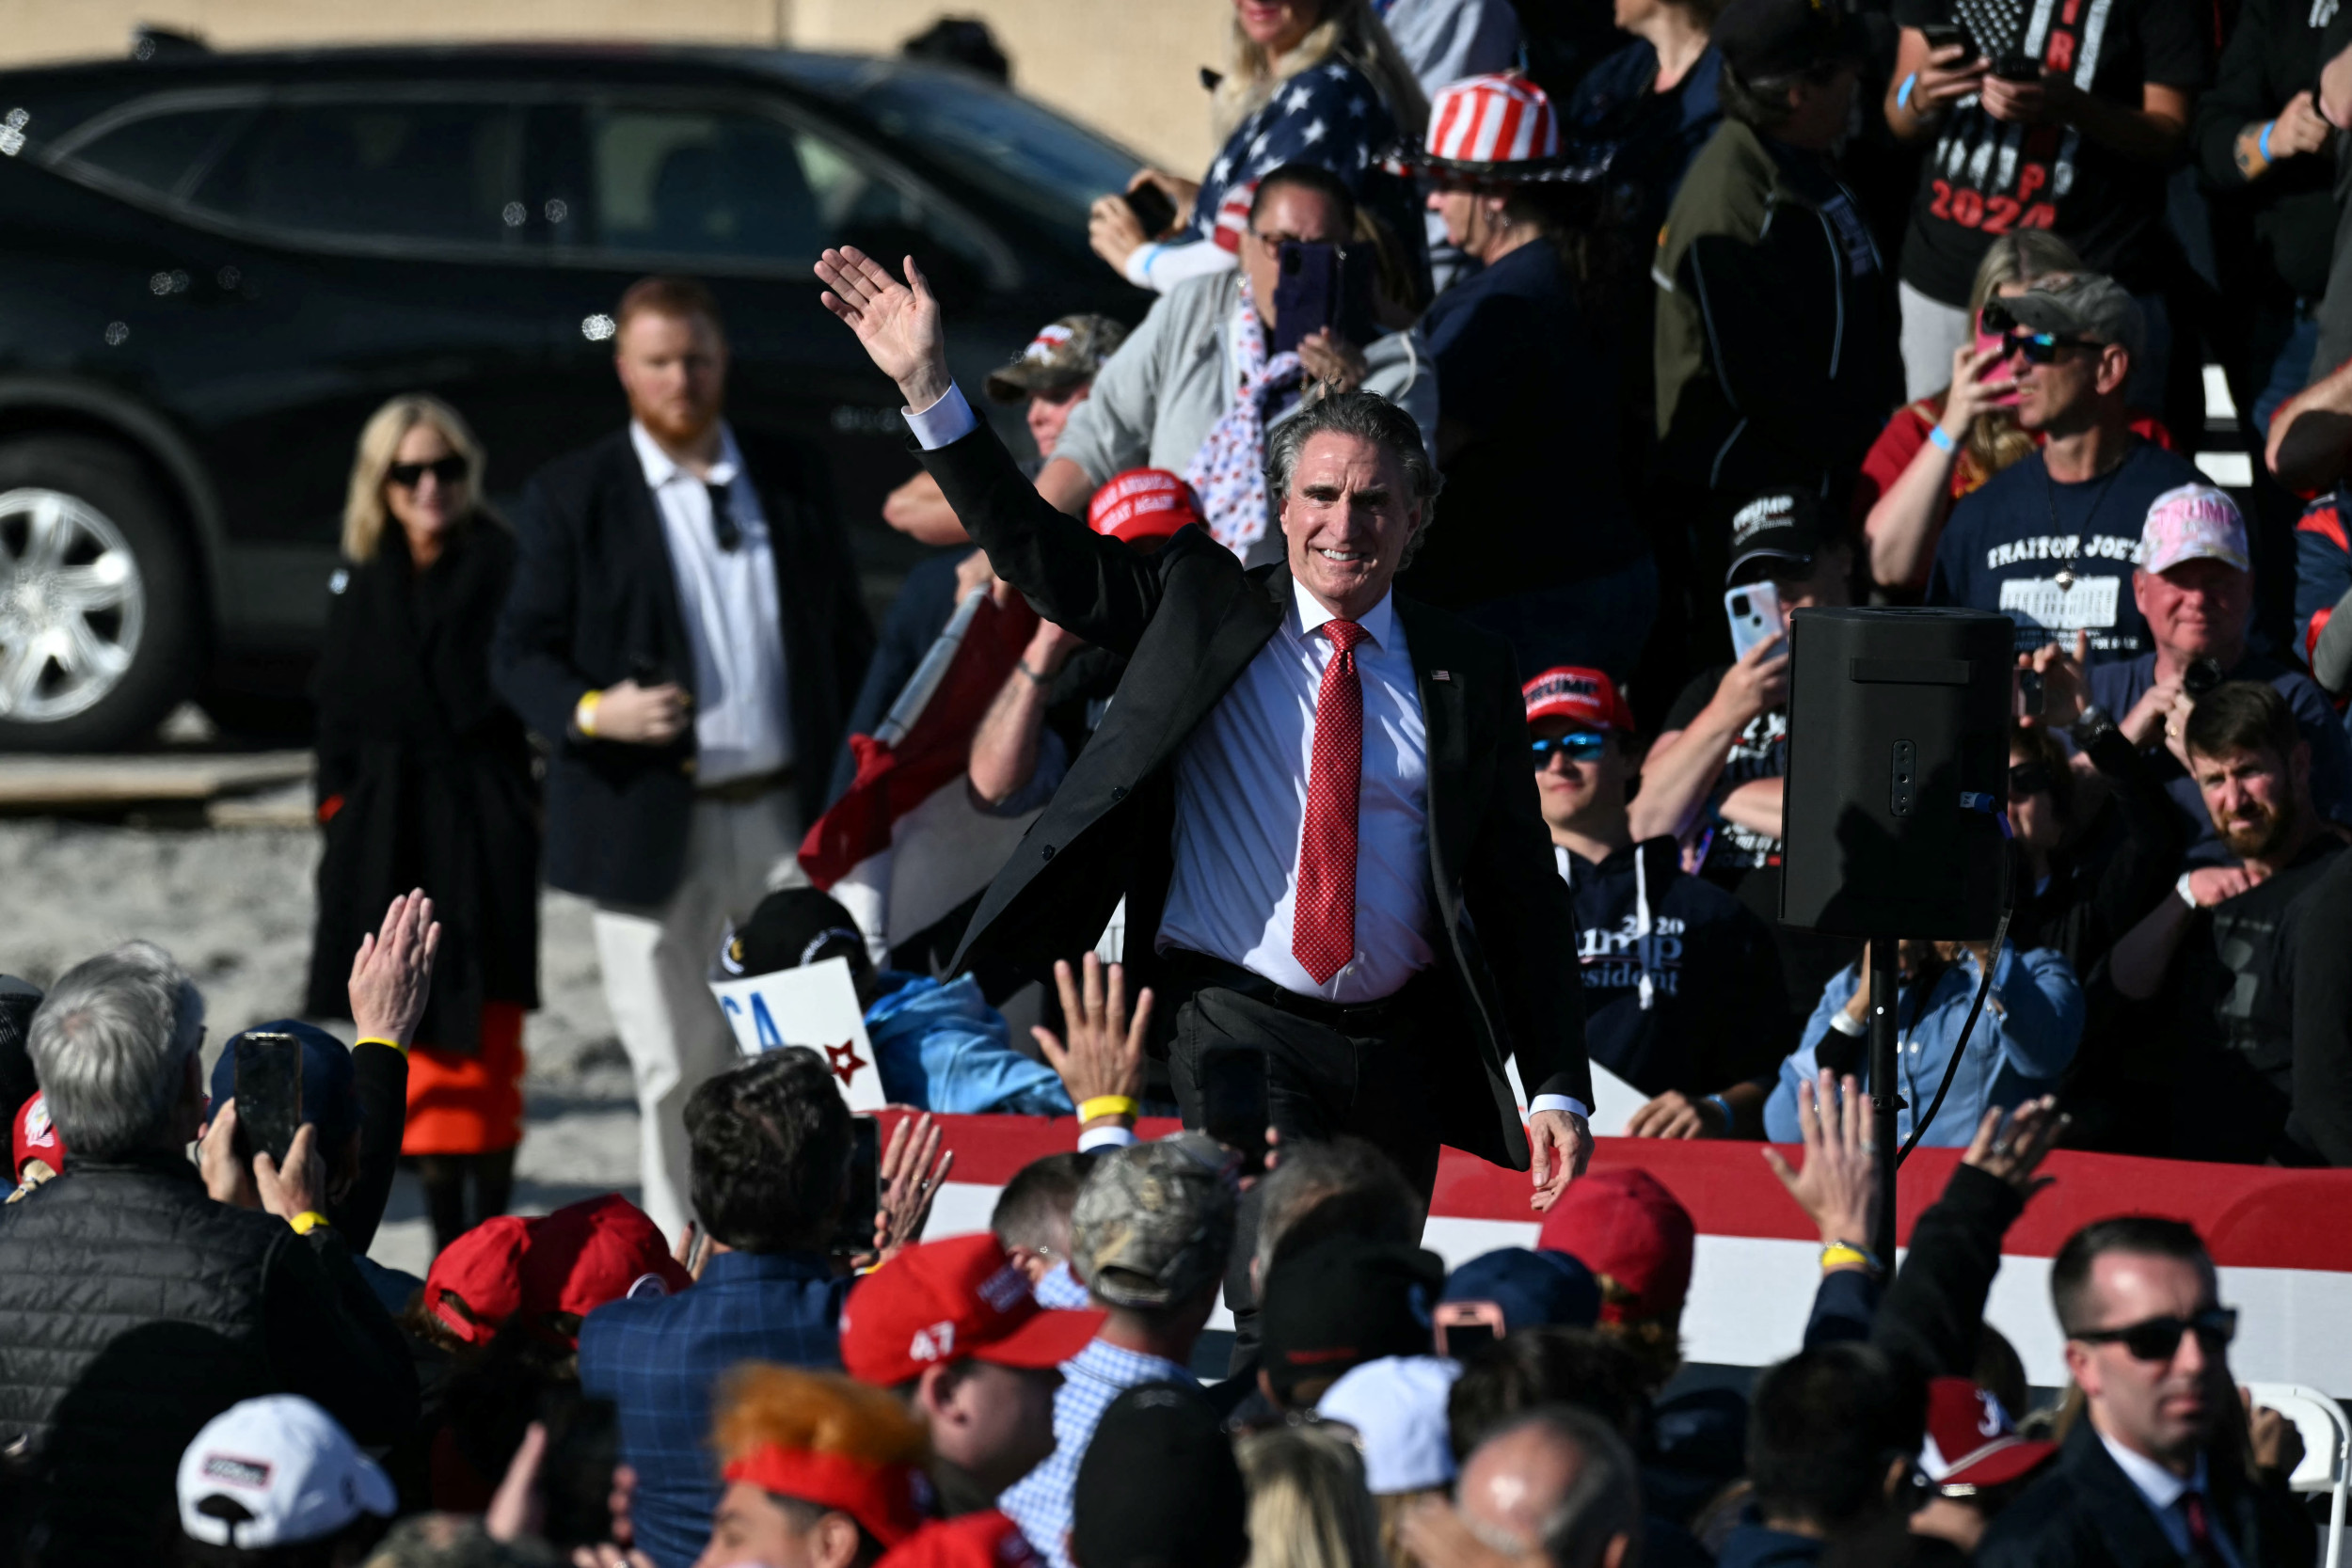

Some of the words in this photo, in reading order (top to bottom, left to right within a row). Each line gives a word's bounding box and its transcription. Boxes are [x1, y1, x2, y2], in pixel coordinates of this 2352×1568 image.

[1733, 495, 1794, 532] TRUMP
[1620, 913, 1685, 936] 220
[909, 1320, 955, 1362] 47
